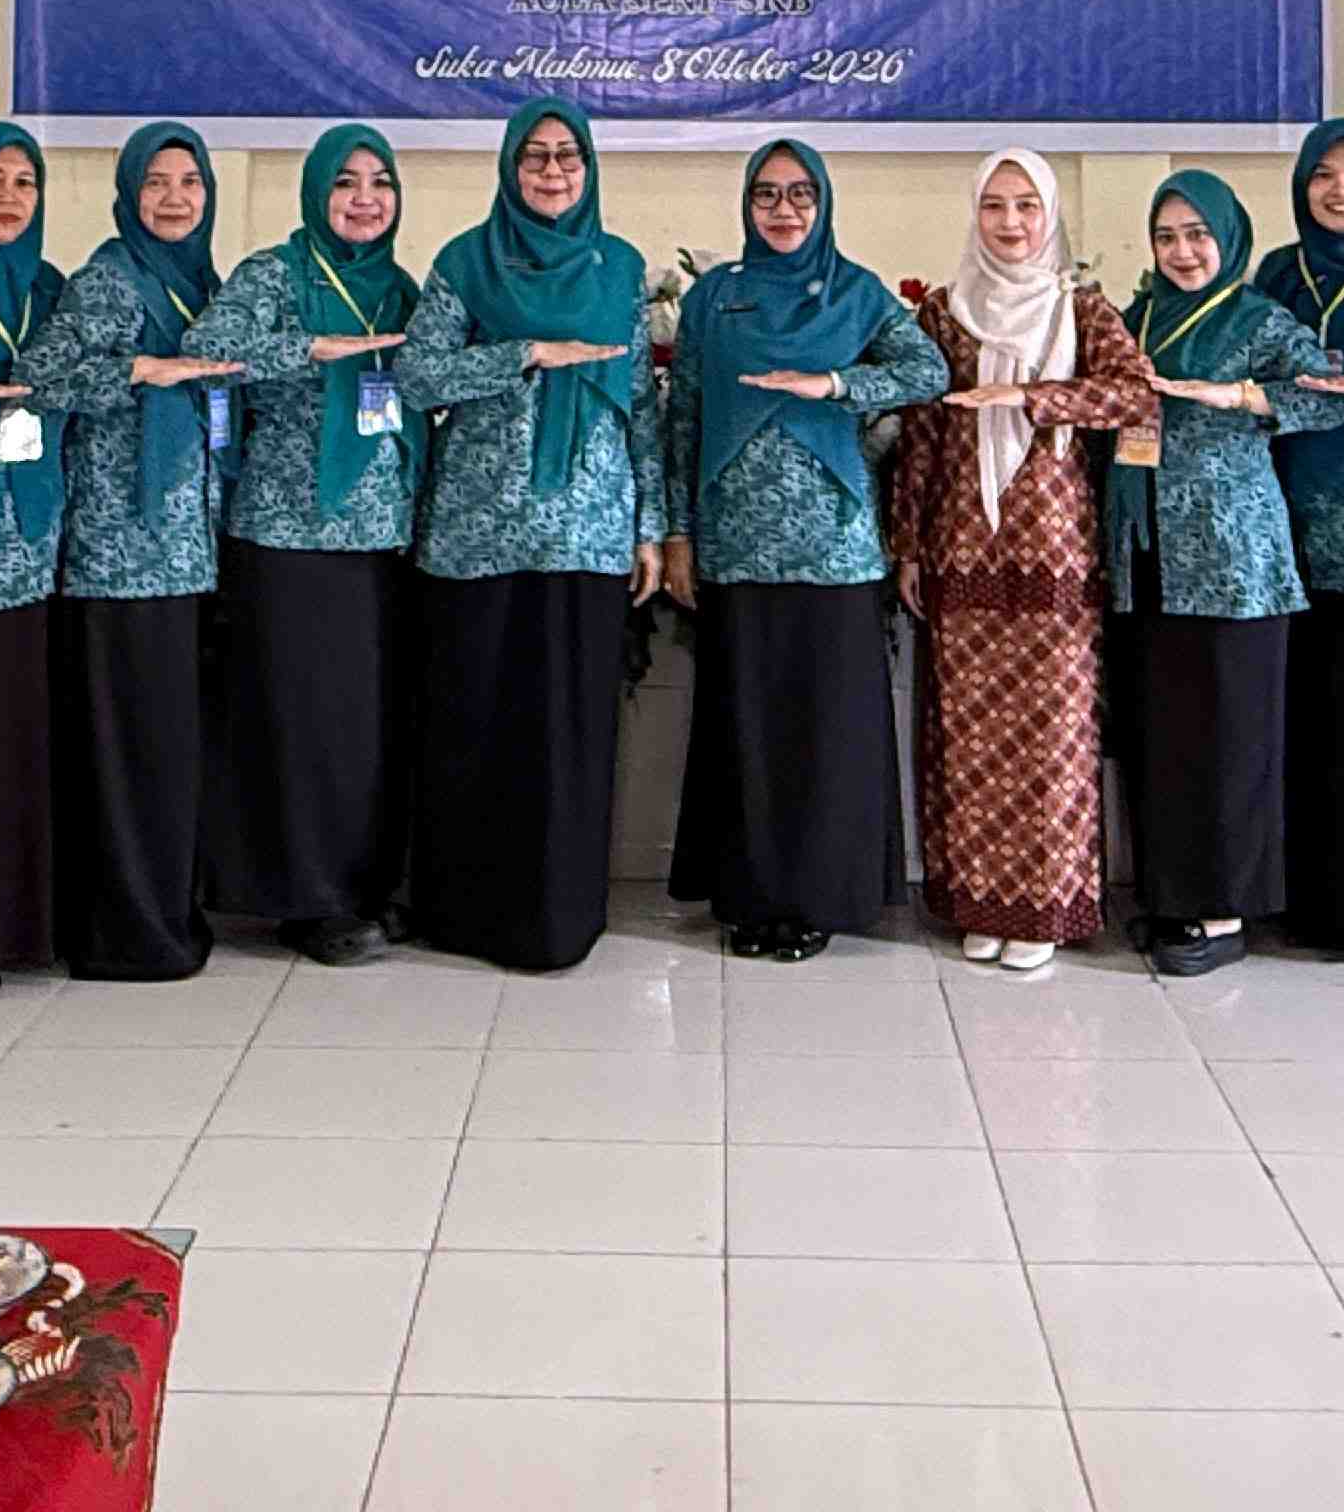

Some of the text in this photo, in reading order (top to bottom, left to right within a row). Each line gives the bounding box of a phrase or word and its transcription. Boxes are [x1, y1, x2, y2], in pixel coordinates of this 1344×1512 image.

[415, 45, 498, 78] Suka
[683, 46, 799, 81] Oktober
[800, 48, 908, 84] 2026
